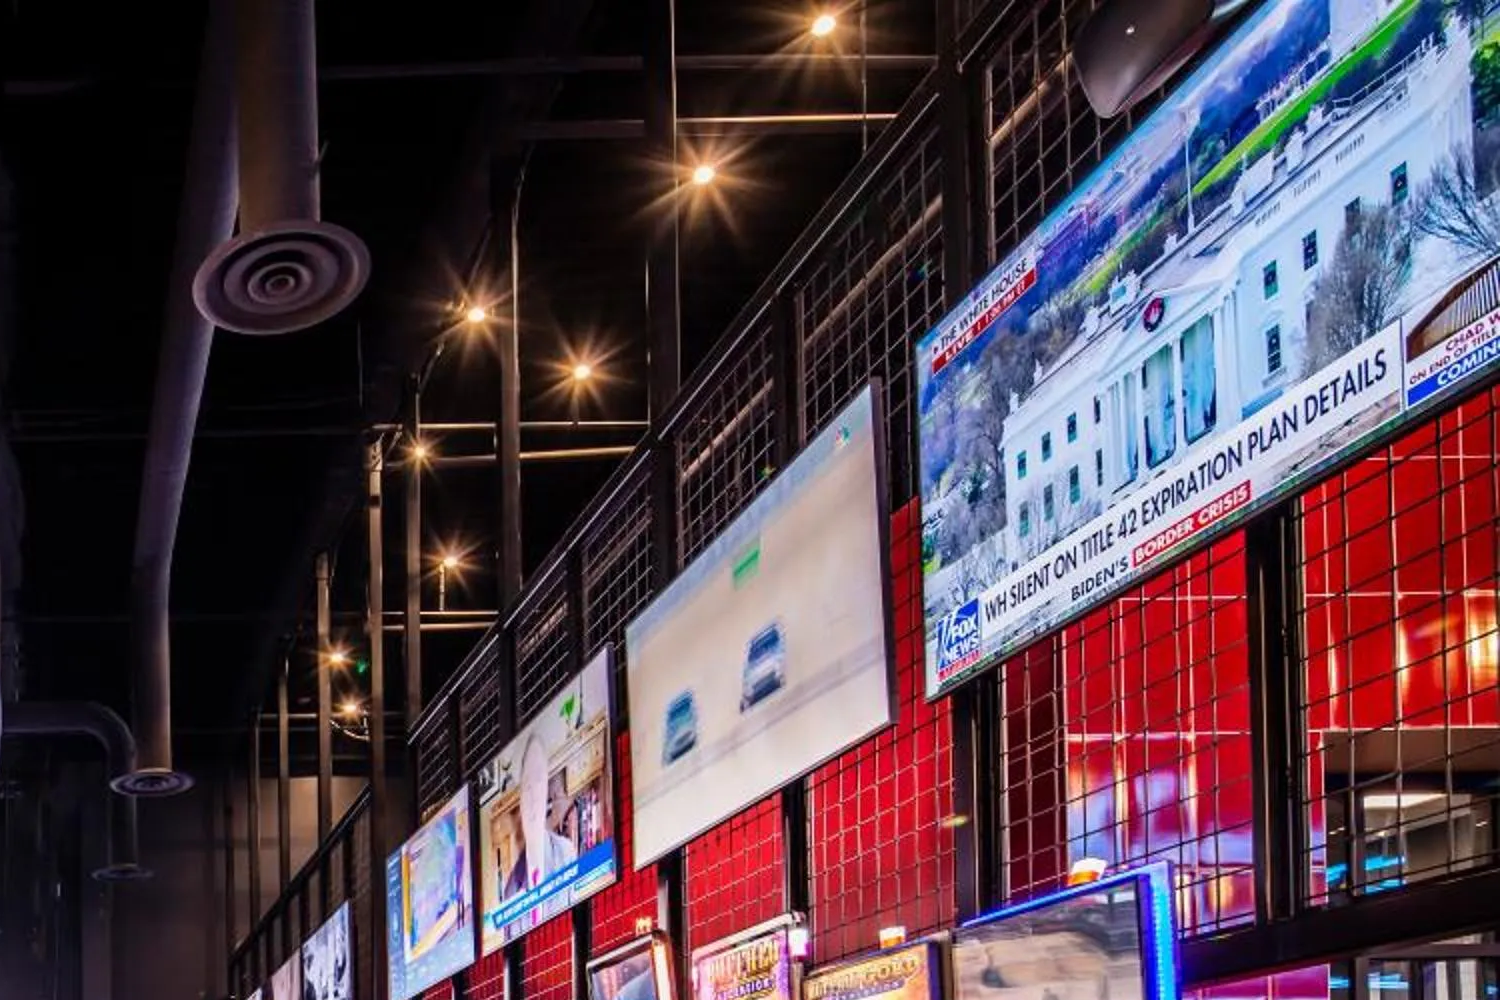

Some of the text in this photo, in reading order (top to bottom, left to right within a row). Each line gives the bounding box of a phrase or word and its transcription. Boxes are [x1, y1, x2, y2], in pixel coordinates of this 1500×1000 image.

[941, 326, 957, 349] THE
[960, 295, 989, 330] WHITE
[991, 257, 1027, 299] HOUSE
[945, 328, 975, 361] LIVE
[1409, 370, 1427, 386] ON
[1430, 355, 1451, 373] END
[1472, 325, 1497, 348] TITLE
[1445, 321, 1485, 352] CHAD
[984, 348, 1388, 622] WH SILENT ON TITLE 42 EXPIRATION PLAN DETAILS
[1071, 484, 1250, 601] BIDEN'S BORDER CRISIS
[944, 635, 980, 663] NEWS
[951, 612, 979, 646] FOX
